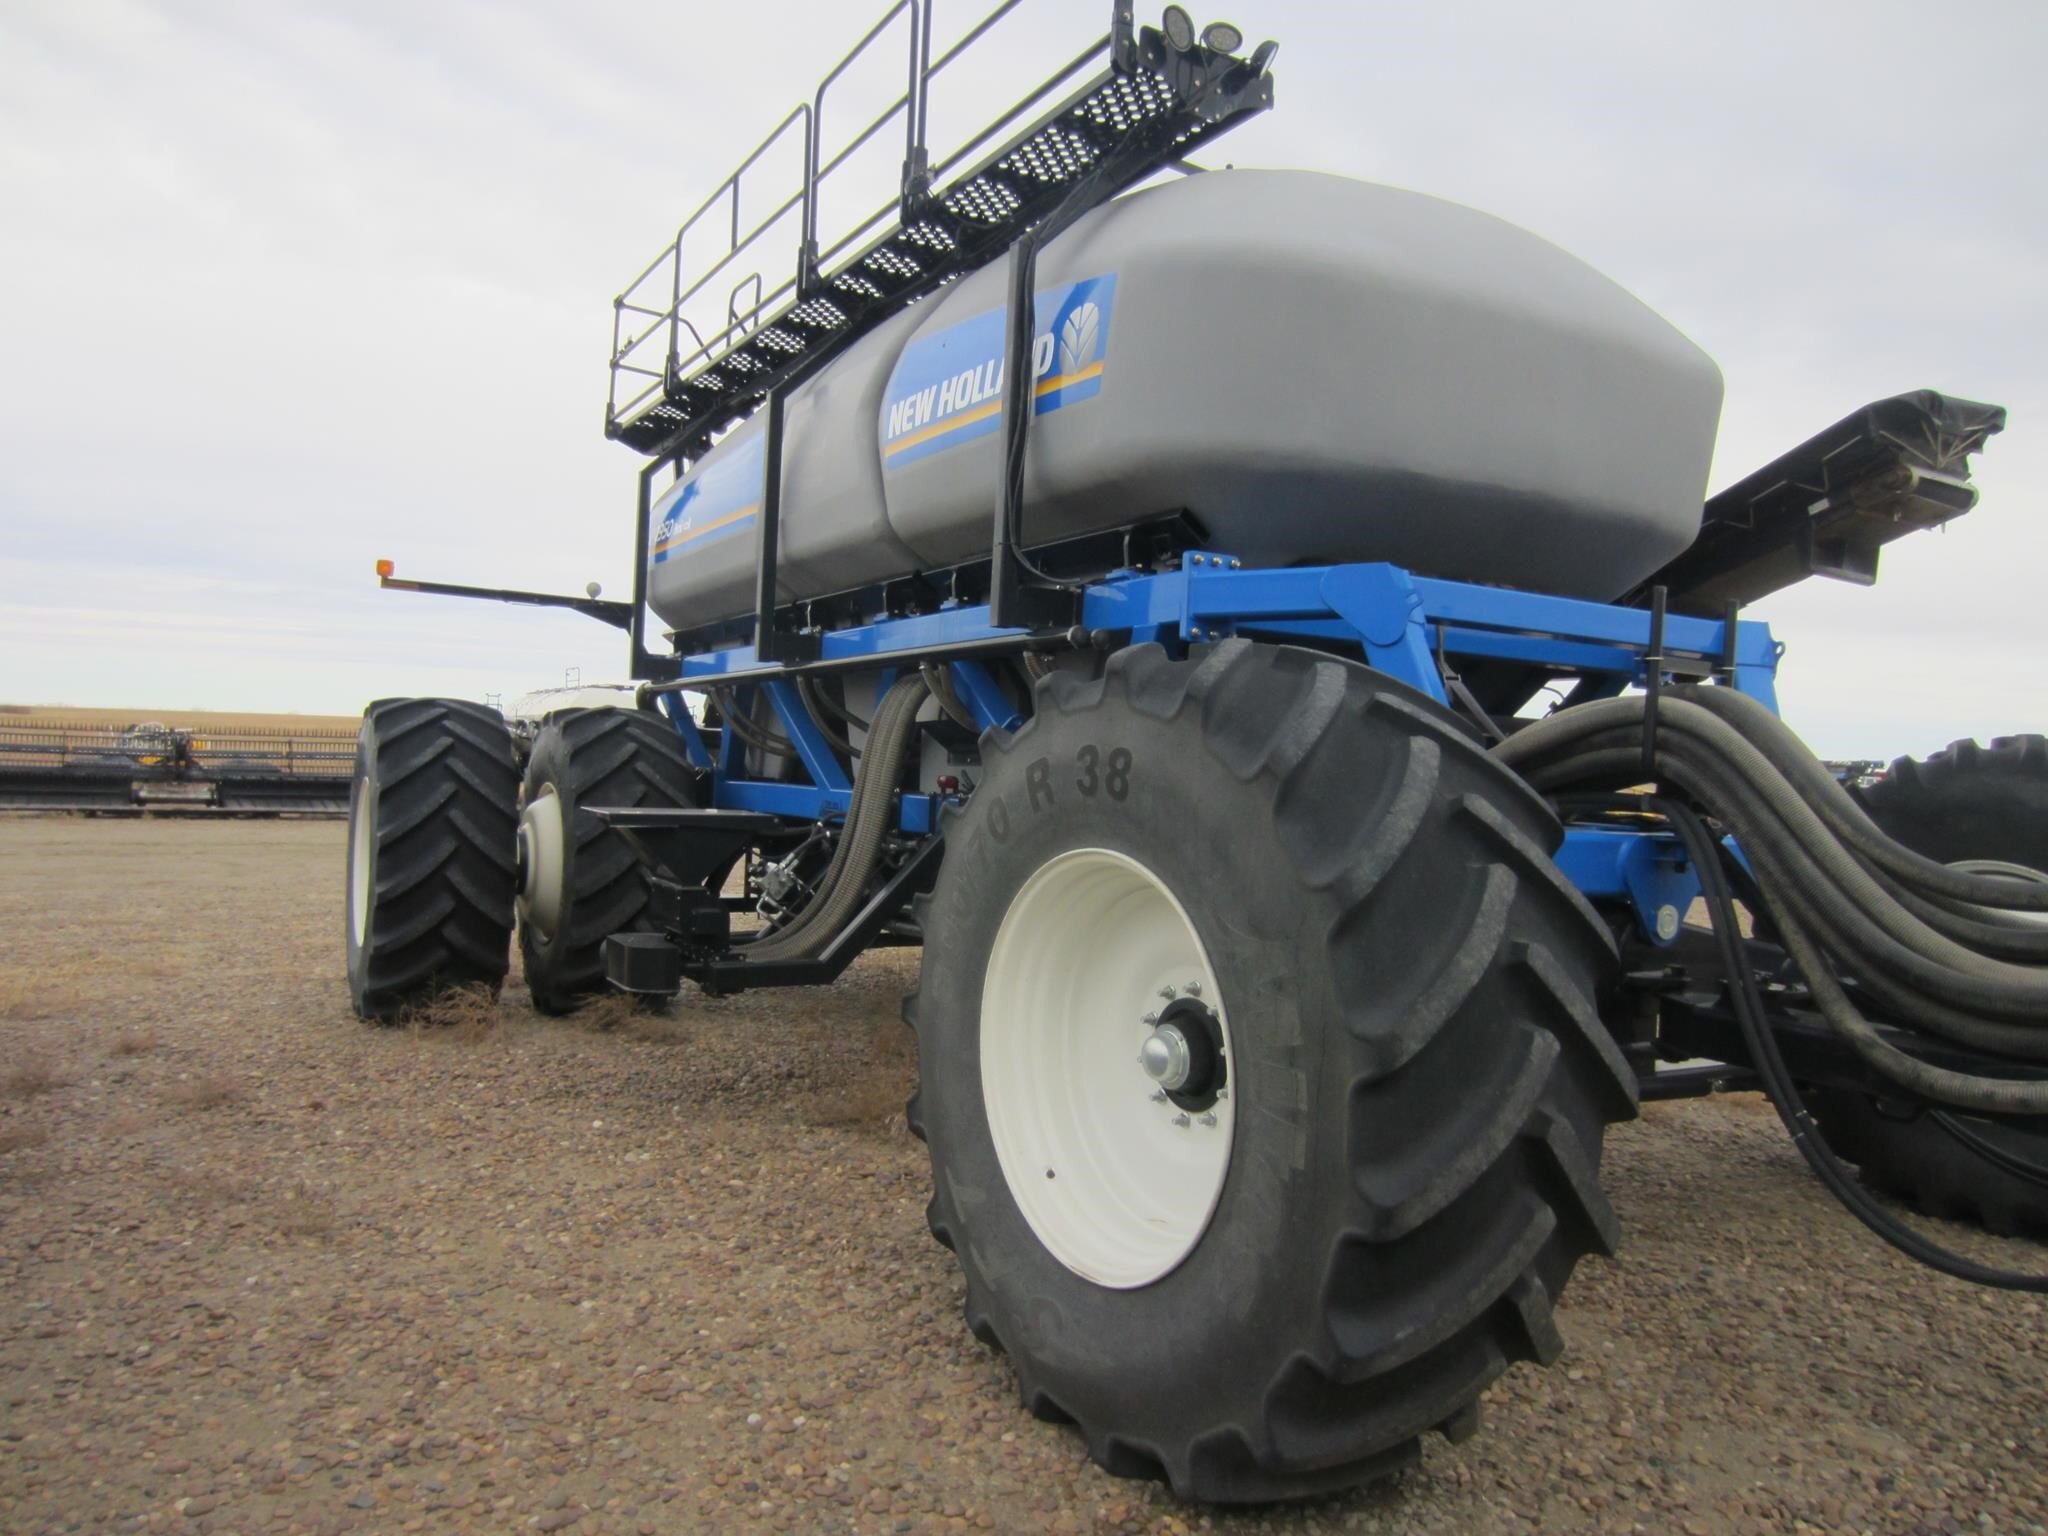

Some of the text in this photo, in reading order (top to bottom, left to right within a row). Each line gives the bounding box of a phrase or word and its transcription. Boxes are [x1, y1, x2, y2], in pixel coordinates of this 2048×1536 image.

[888, 384, 937, 439] NEW
[1025, 757, 1055, 813] R
[1076, 744, 1133, 802] 38
